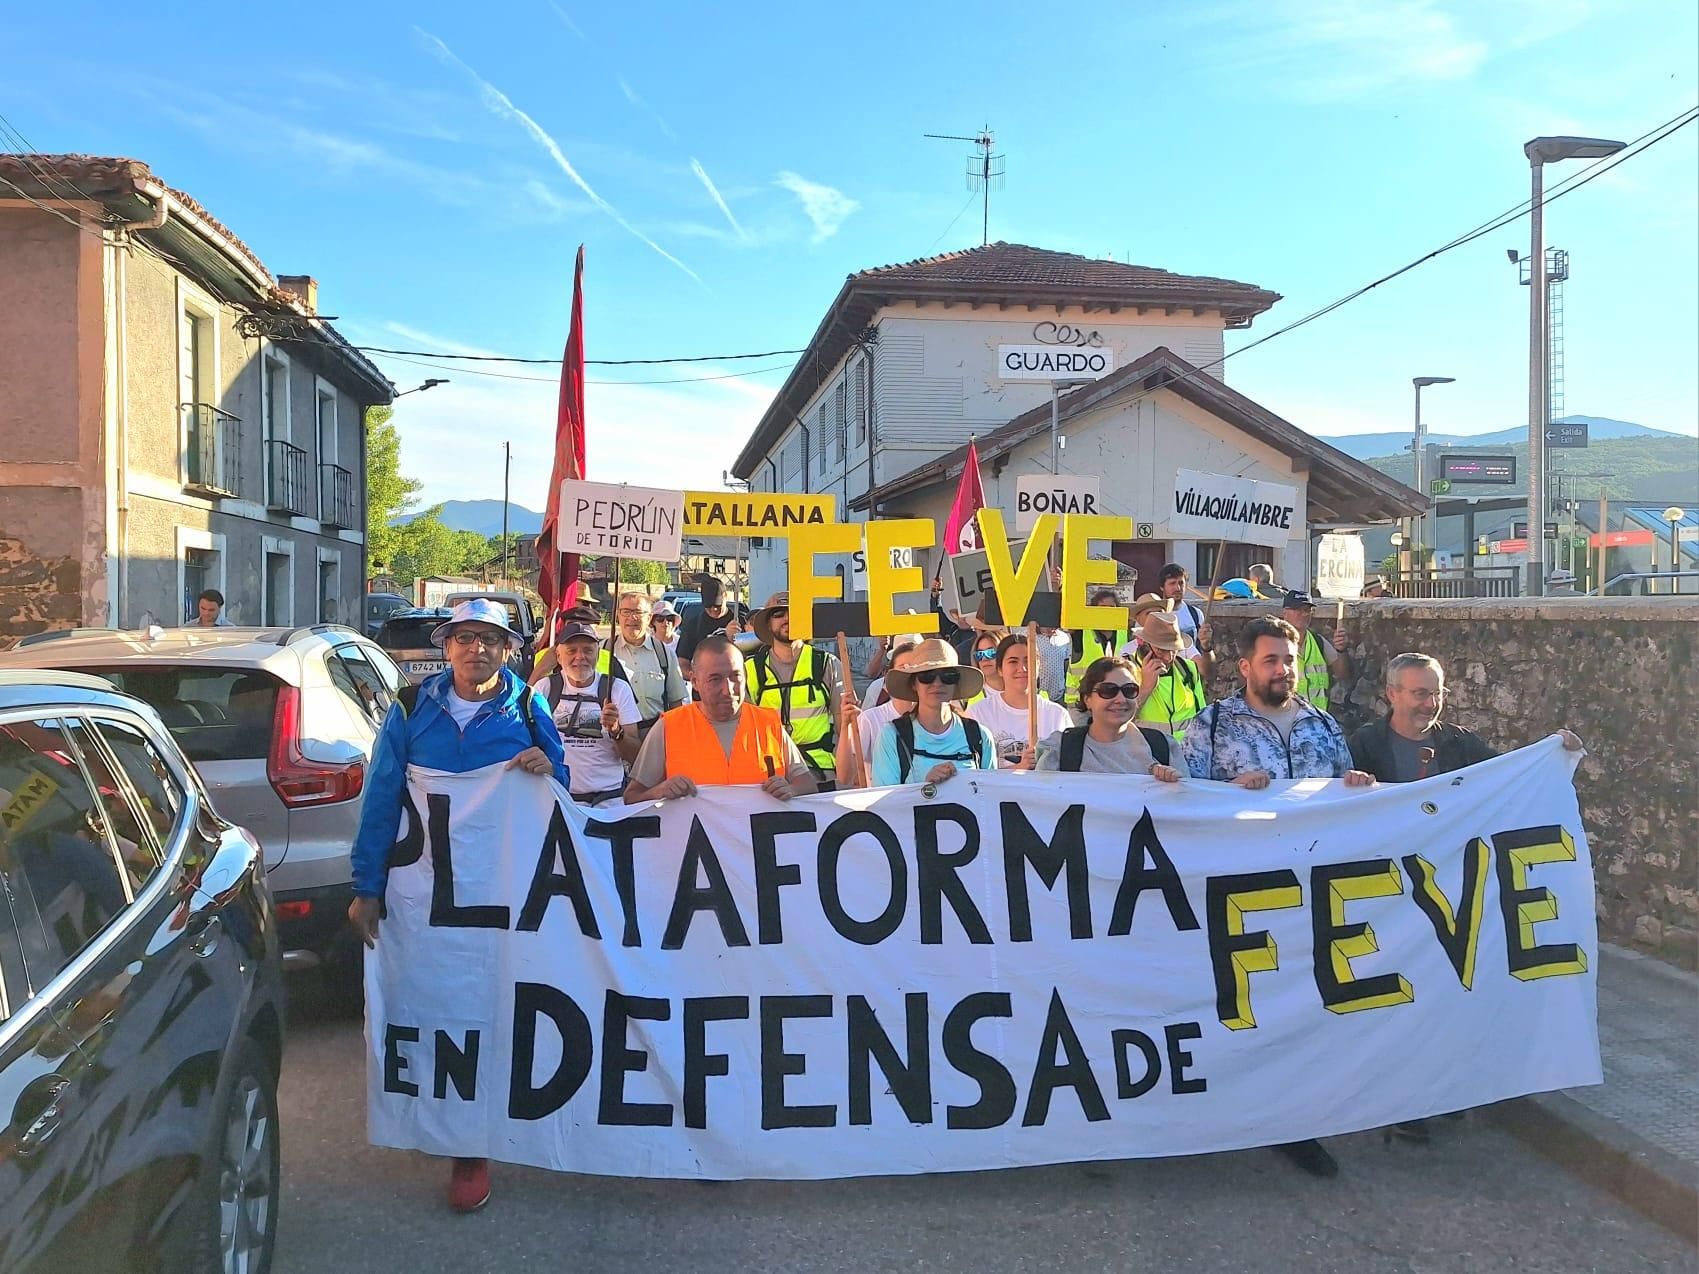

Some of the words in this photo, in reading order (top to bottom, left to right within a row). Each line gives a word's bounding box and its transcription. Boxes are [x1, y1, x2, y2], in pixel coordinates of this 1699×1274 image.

[1005, 352, 1106, 372] GUARDO
[1560, 427, 1583, 436] Salida
[1018, 489, 1098, 515] BOÑAR
[575, 497, 676, 536] PEDRÚN
[576, 532, 591, 545] DE
[412, 663, 434, 671] 6742
[1206, 824, 1588, 1031] FEVE
[384, 1023, 480, 1100] EN
[508, 982, 1111, 1129] DEFENSA
[1111, 1022, 1207, 1100] DE
